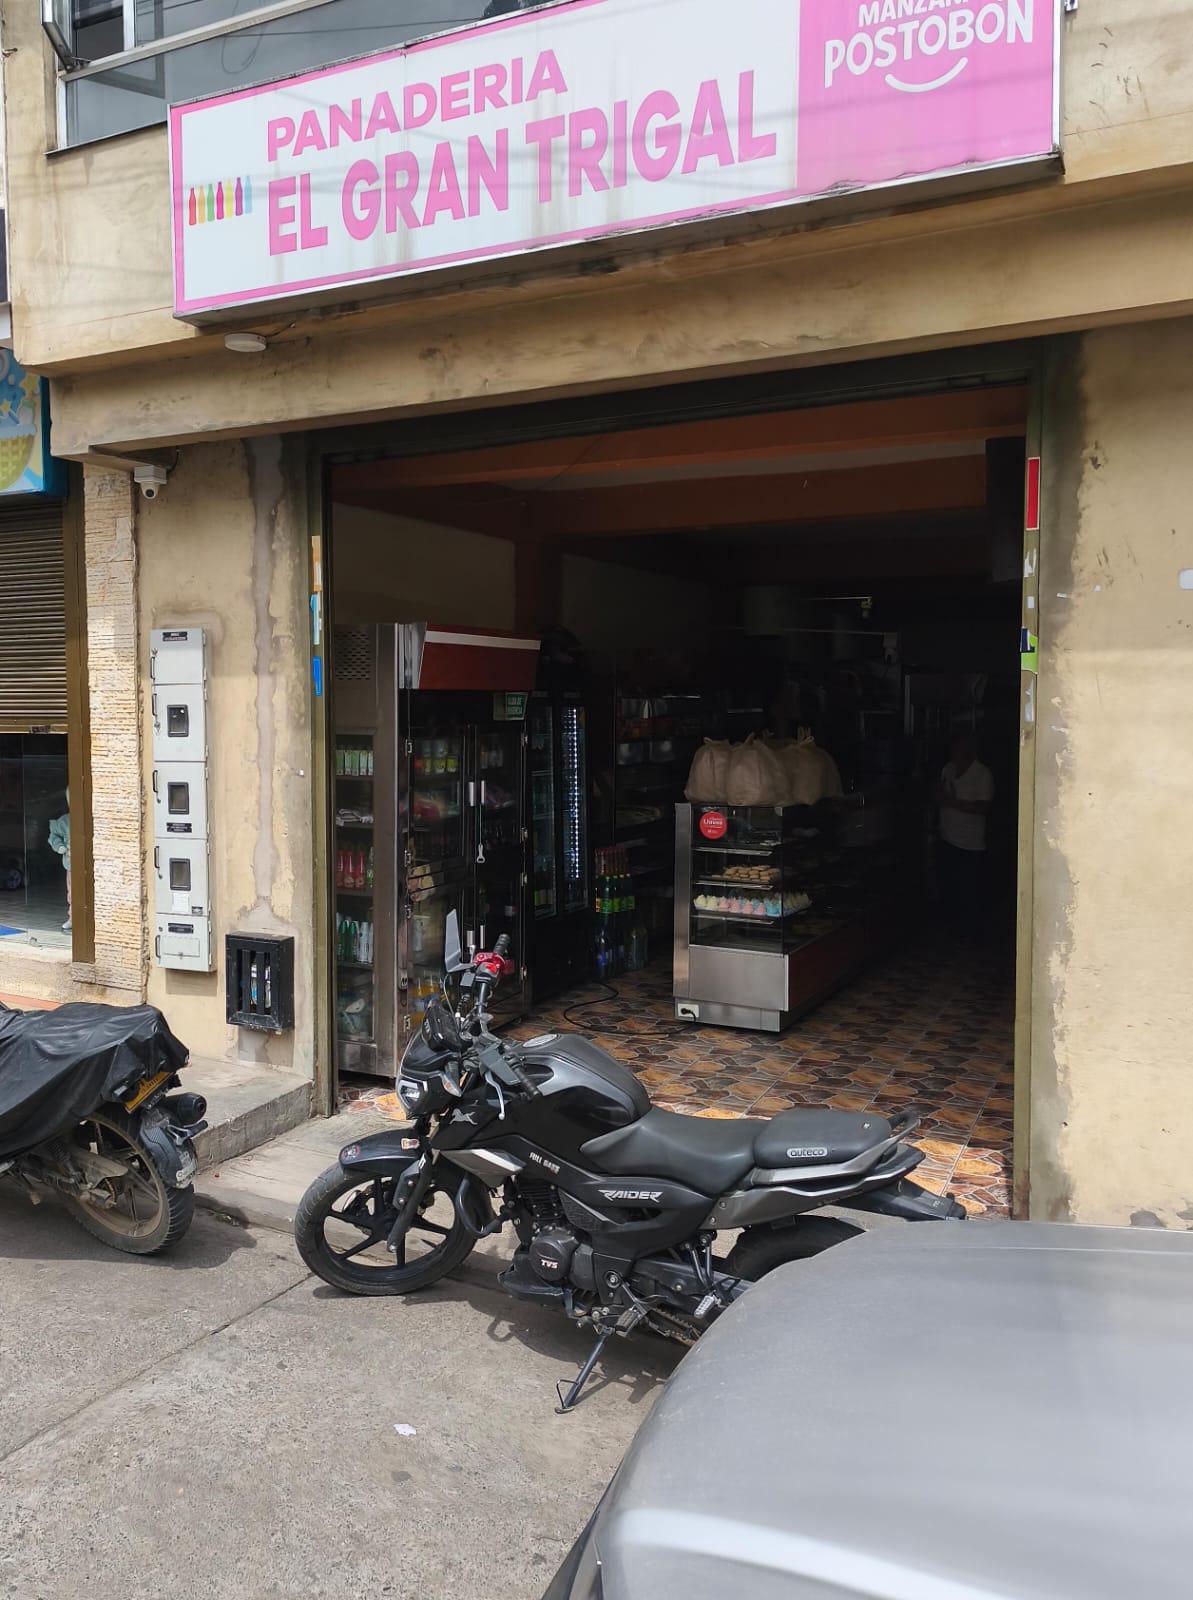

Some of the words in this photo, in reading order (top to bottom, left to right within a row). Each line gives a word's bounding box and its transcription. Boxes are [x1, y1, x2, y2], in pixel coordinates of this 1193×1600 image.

[267, 49, 568, 162] PANADERIA
[268, 173, 328, 256] EL
[341, 128, 509, 241] GRAN
[525, 70, 777, 204] TRIGAL
[789, 1148, 825, 1157] auteco
[597, 1189, 664, 1203] RAIDER
[541, 1259, 558, 1269] TVS
